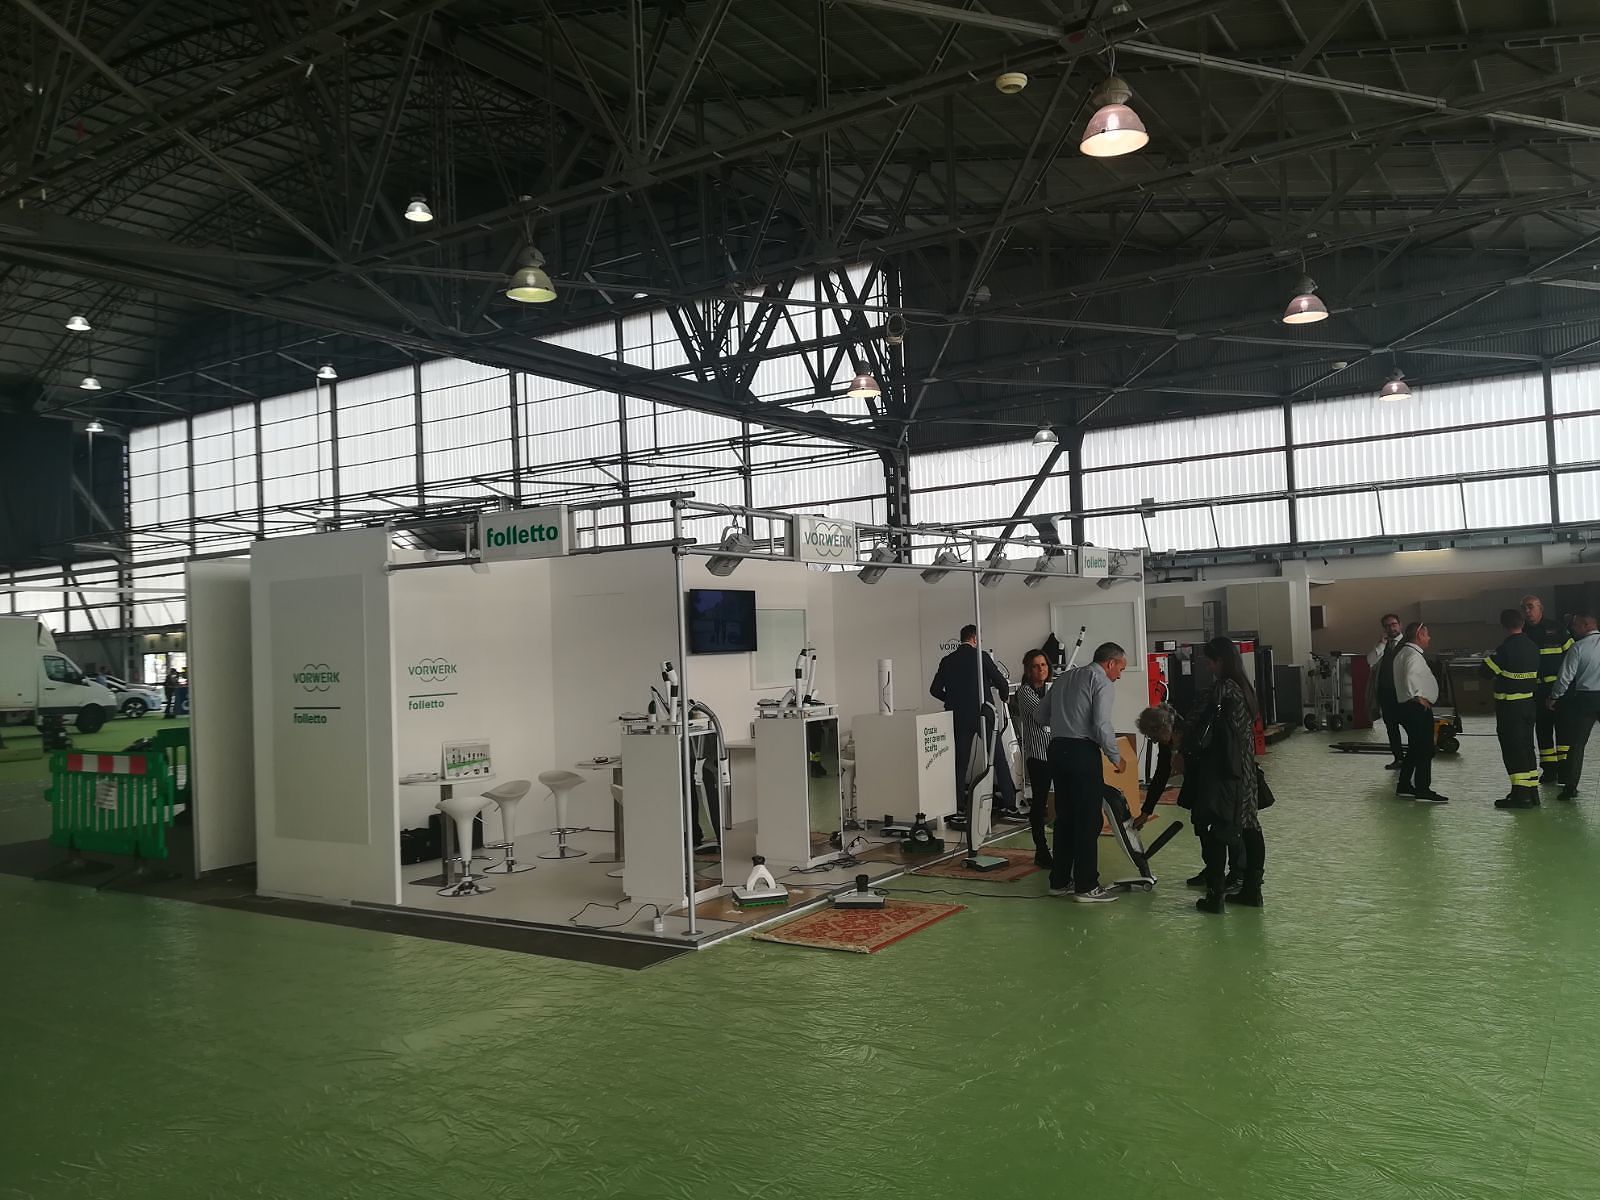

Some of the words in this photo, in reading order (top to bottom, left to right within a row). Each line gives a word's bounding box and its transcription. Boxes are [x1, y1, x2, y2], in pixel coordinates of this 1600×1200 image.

[486, 524, 558, 548] folletto
[804, 531, 852, 549] VORWERK
[407, 664, 457, 675] VORWERK
[293, 671, 340, 684] VORWERK
[408, 699, 445, 711] folletto
[293, 712, 328, 724] folletto
